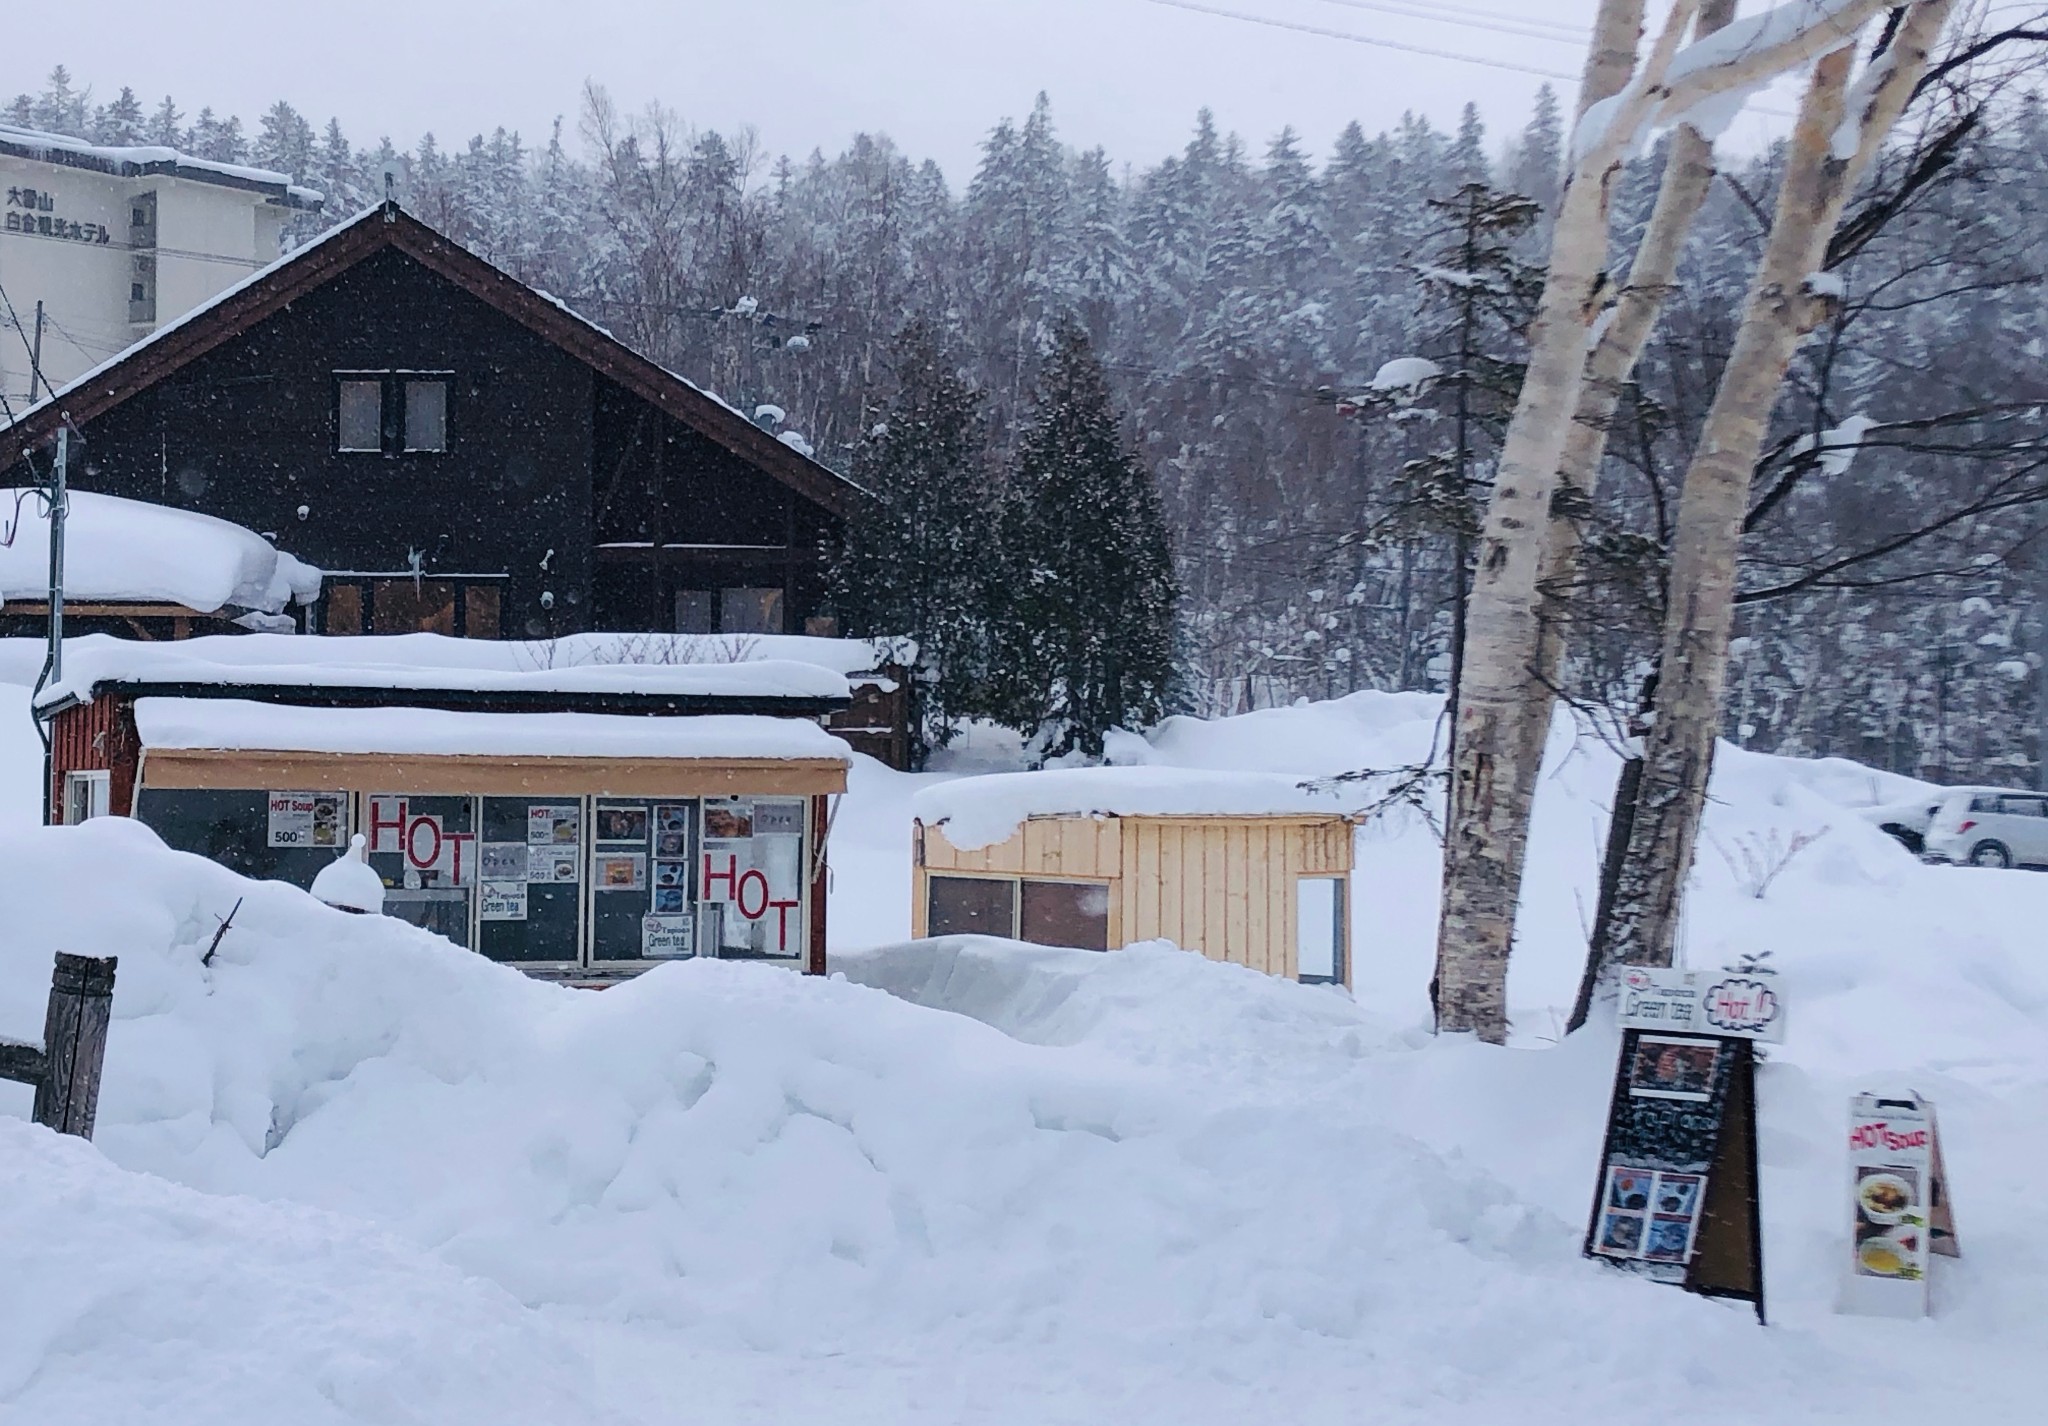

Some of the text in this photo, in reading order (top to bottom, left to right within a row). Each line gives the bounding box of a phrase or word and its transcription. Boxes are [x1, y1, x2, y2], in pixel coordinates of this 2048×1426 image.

[271, 800, 314, 813] HOT Soup
[530, 809, 551, 819] HOT
[275, 831, 298, 843] 500
[371, 802, 475, 886] HOT
[481, 898, 519, 912] Green tea
[704, 854, 798, 951] HOT
[648, 933, 671, 947] Green
